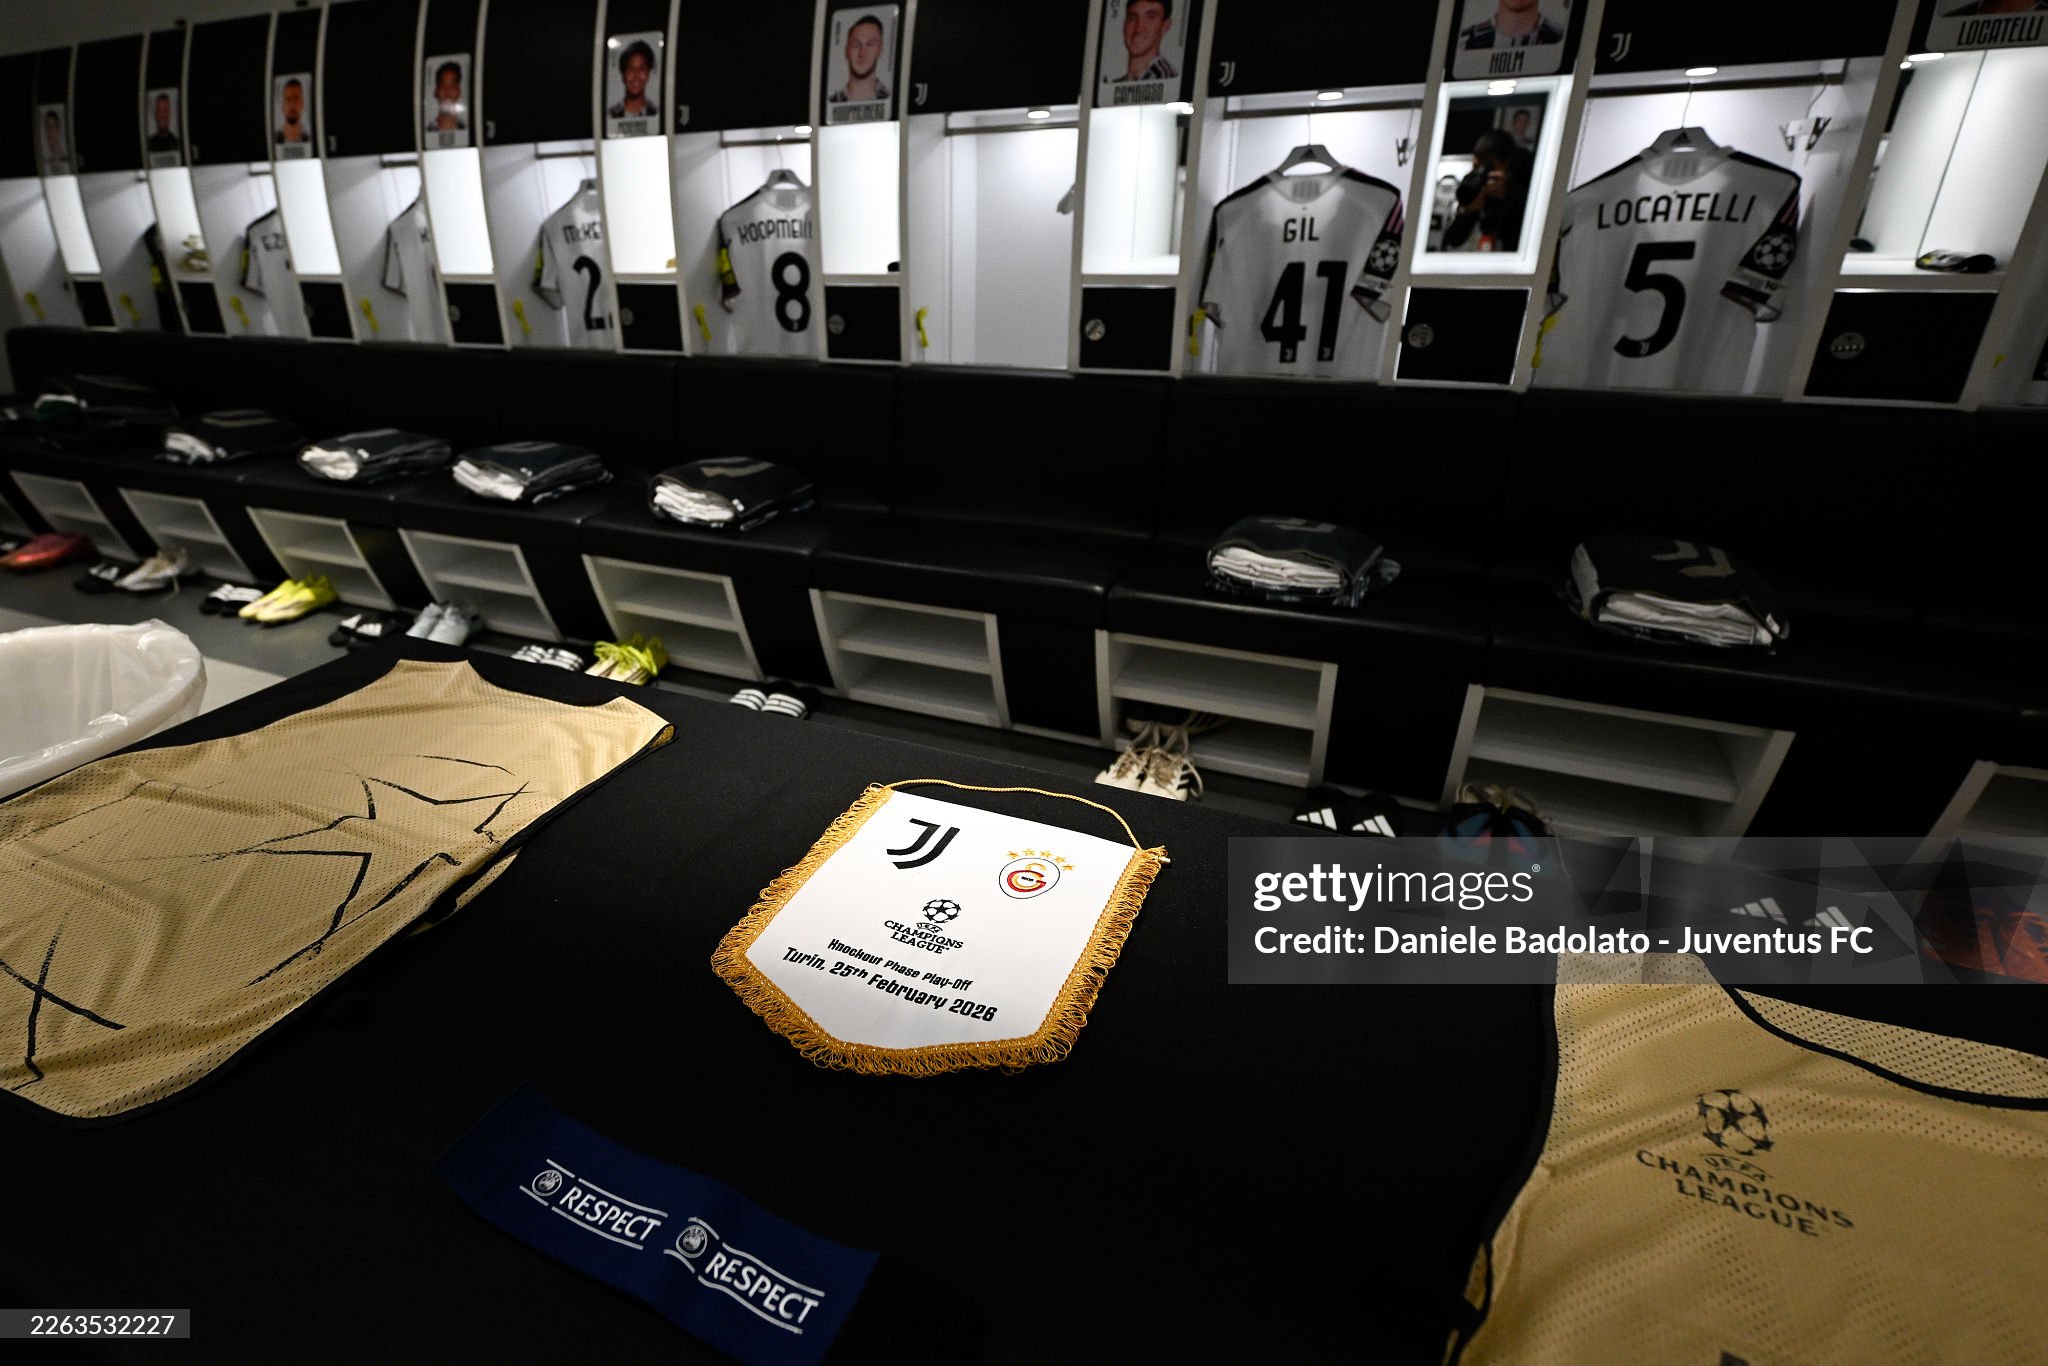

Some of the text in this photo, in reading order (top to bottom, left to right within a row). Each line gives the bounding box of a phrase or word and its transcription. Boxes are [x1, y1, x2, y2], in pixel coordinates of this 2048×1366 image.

[1957, 15, 2044, 46] LOCATELLI
[1489, 50, 1525, 74] HOLM
[1283, 216, 1320, 243] GIL
[1597, 192, 1756, 230] LOCATELLI
[771, 251, 811, 333] 8
[1261, 261, 1348, 363] 41
[1613, 241, 1697, 358] 5
[884, 920, 964, 949] CHAMPIONS
[890, 931, 944, 954] LEAGUE
[782, 946, 998, 1022] Turin, 25th February 2026
[827, 938, 974, 991] Knockout Phase Play-Off
[1635, 1149, 1855, 1229] CHAMPIONS
[1702, 1154, 1770, 1183] UEFA
[559, 1186, 662, 1241] RESPECT
[1675, 1178, 1819, 1237] LEAGUE
[704, 1252, 819, 1324] RESPECT
